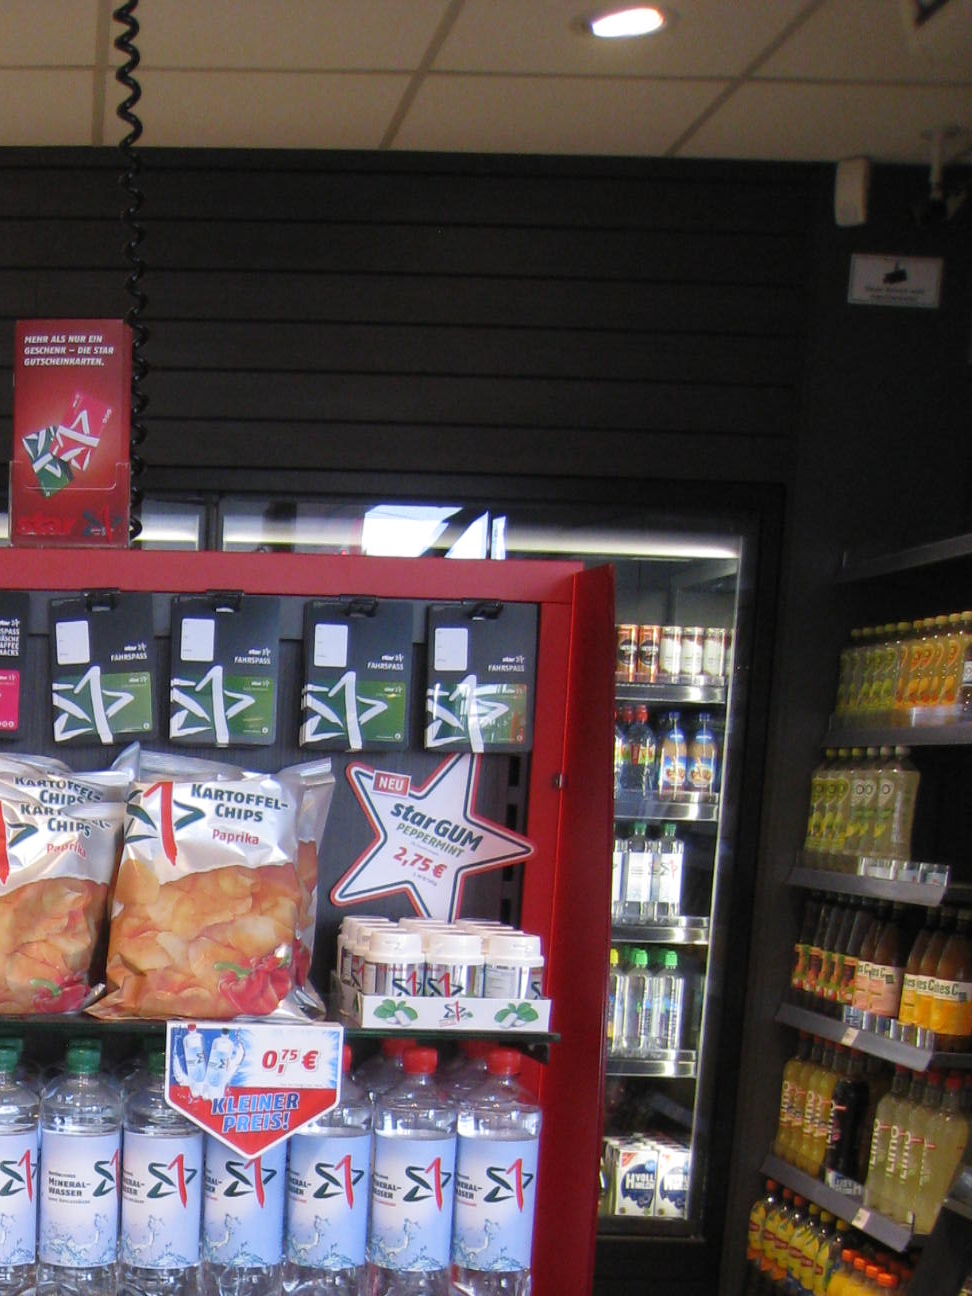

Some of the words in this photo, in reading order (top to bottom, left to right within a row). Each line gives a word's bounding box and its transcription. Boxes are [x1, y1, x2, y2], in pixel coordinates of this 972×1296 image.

[24, 336, 48, 344] MEHR
[51, 335, 66, 343] ALS
[68, 335, 86, 343] NUR
[88, 335, 103, 343] EIN
[24, 346, 66, 355] GESCHENK
[93, 346, 114, 354] STAR
[24, 358, 105, 366] GUTSCHEINKARTEN.
[110, 653, 148, 662] FAHRSPASS
[234, 655, 271, 665] FAHRSPASS
[367, 662, 404, 671] FAHRSPASS
[488, 664, 525, 672] FAHRSPASS
[377, 776, 405, 791] NEU
[190, 783, 289, 811] KARTOFFEL-
[214, 803, 264, 823] CHIPS
[47, 817, 91, 837] CHIPS
[211, 828, 260, 846] Paprika
[396, 822, 465, 858] PEPPERMINT
[46, 840, 86, 858] Paprika
[392, 846, 433, 872] 2,75
[301, 1050, 319, 1070] €
[211, 1092, 300, 1116] KLEINER
[222, 1111, 290, 1133] PREIS!
[48, 1177, 91, 1189] MINERAL-
[48, 1186, 83, 1198] WASSER
